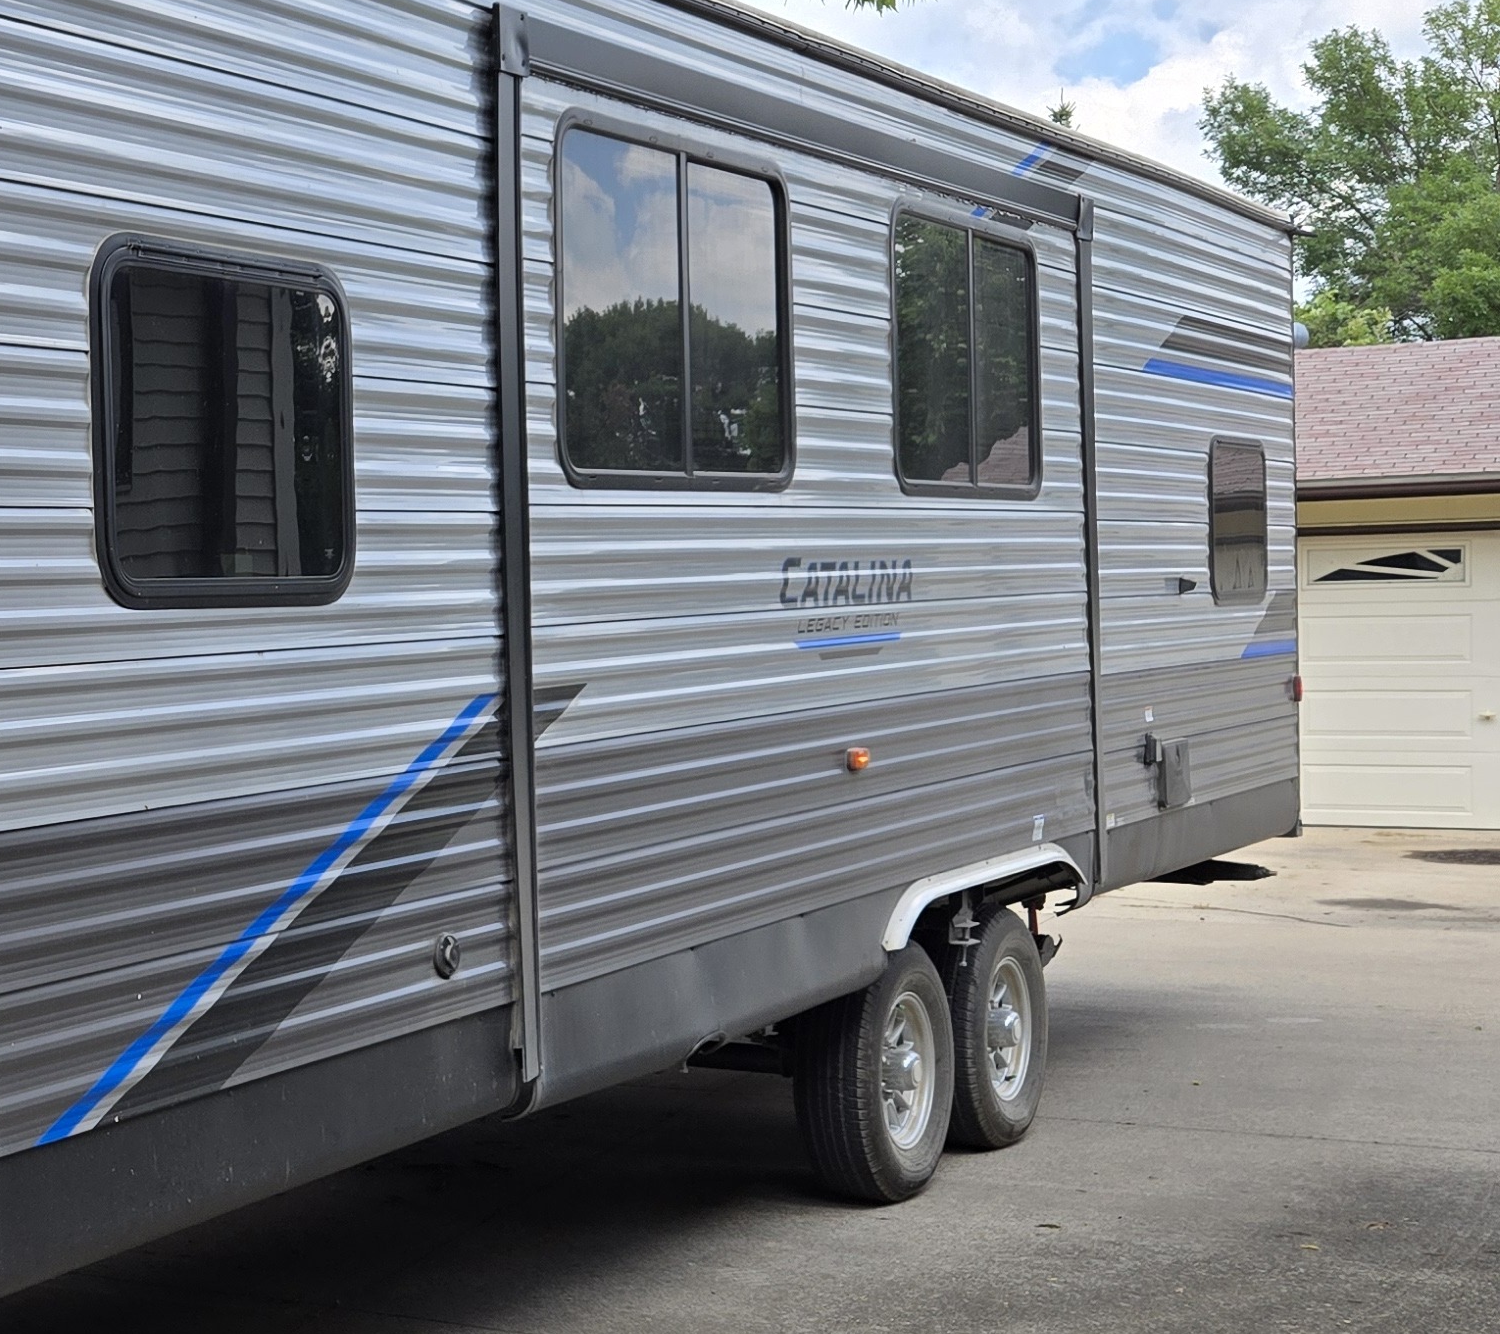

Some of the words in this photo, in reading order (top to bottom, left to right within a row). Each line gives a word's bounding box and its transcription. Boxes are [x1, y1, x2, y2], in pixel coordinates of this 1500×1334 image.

[779, 556, 913, 607] CATALINA
[797, 615, 851, 634] LEGACY
[854, 611, 900, 629] EDITION
